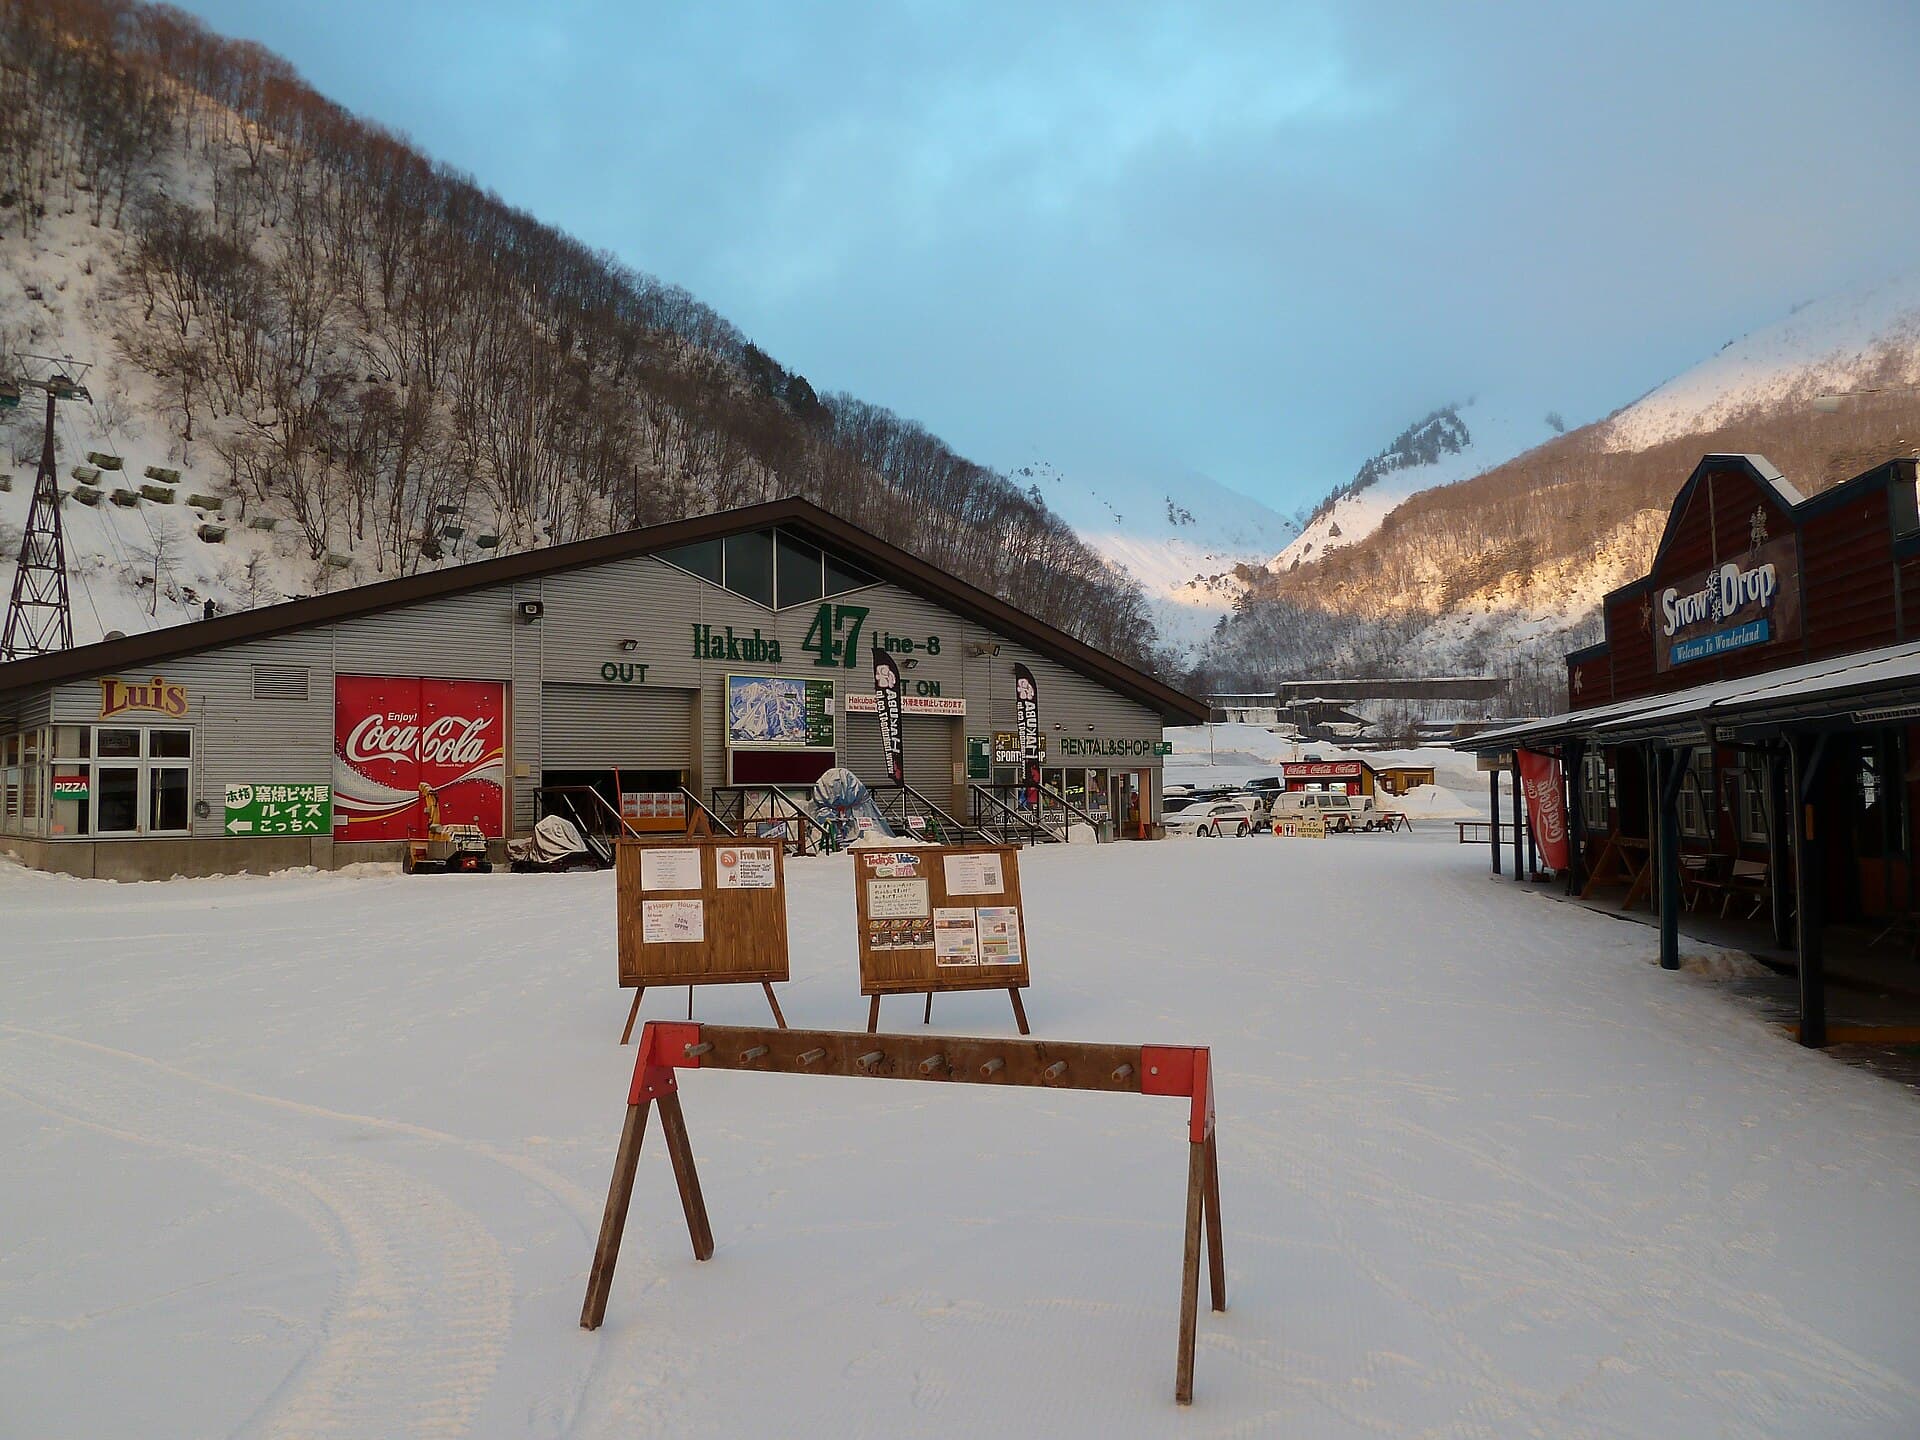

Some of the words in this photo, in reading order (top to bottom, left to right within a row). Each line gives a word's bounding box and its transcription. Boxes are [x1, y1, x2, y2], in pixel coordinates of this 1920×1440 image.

[1663, 588, 1710, 636] Snow
[1720, 564, 1775, 616] Drop
[692, 623, 782, 663] Hakuba
[802, 603, 870, 669] 47
[872, 631, 941, 655] Line-8
[1677, 644, 1703, 661] Welcome
[1705, 639, 1713, 653] To
[1714, 624, 1760, 649] Wonderland
[601, 662, 650, 683] OUT
[917, 680, 941, 696] ON
[102, 678, 186, 717] Luis
[387, 712, 418, 722] Enjoy!
[1061, 738, 1150, 756] RENTAL&SHOP
[55, 782, 88, 793] PIZZA
[226, 788, 250, 802] 本格
[256, 786, 329, 802] 窯焼ピザ屋
[261, 804, 322, 817] ルイス
[260, 820, 319, 832] こっちへ
